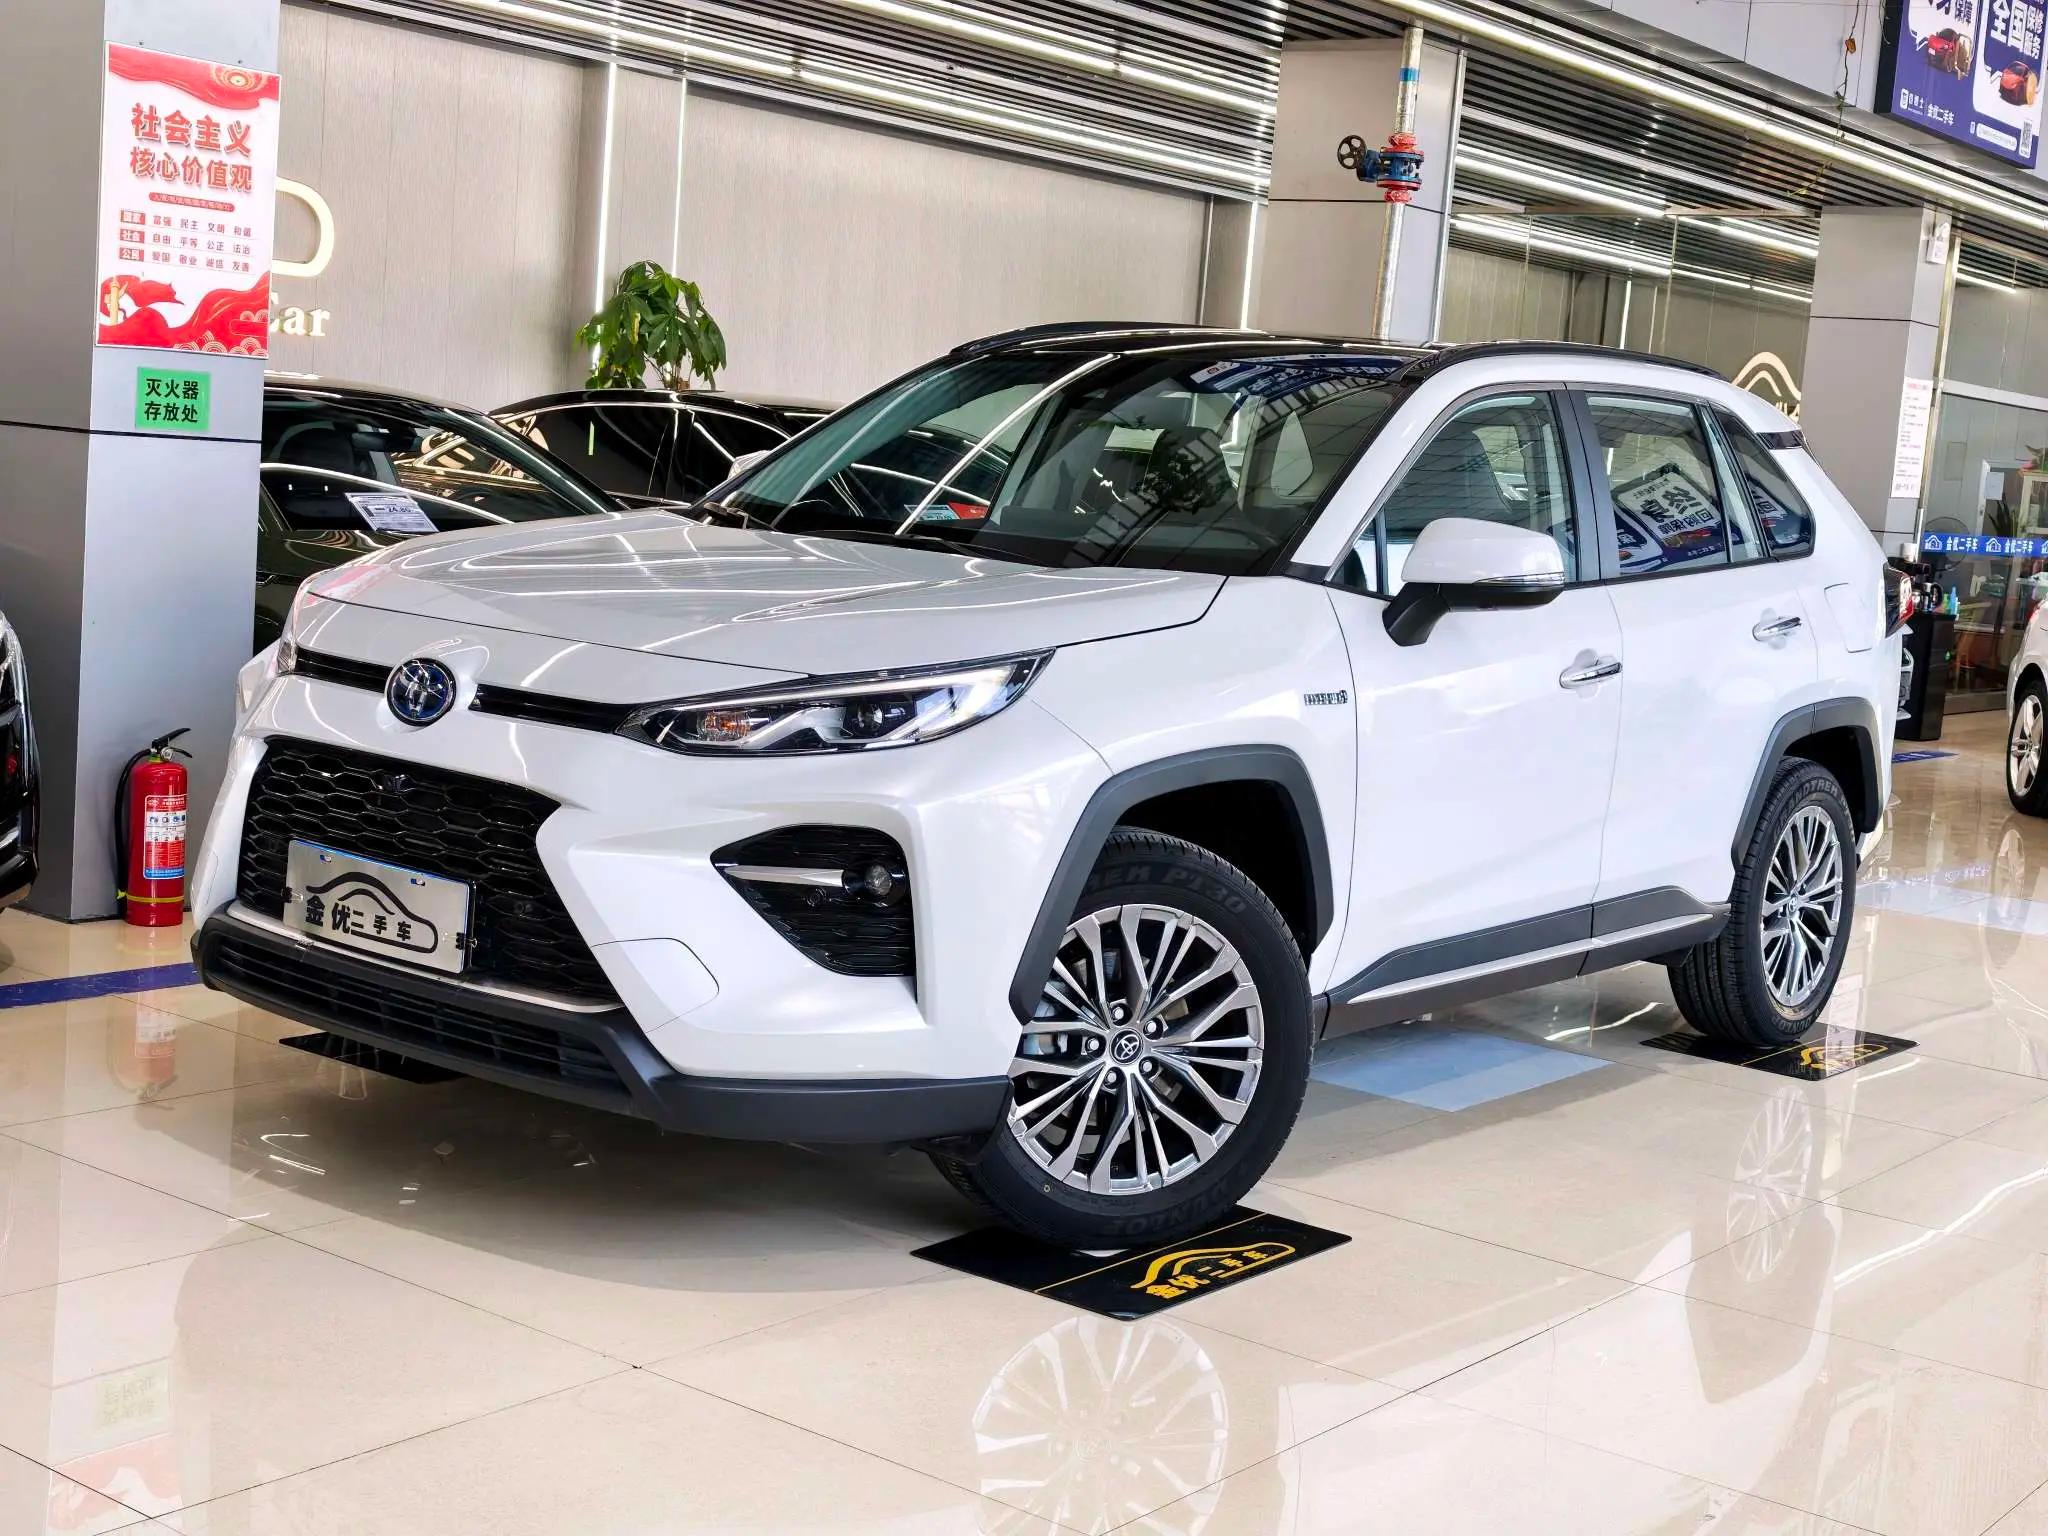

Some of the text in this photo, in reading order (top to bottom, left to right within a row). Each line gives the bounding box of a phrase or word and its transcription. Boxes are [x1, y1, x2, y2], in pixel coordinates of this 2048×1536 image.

[131, 103, 251, 157] 社会主义
[130, 146, 252, 193] 核心价值观
[153, 233, 171, 244] 自由
[207, 240, 224, 251] 公正
[270, 292, 331, 337] ar
[145, 378, 199, 400] 灭火器
[144, 401, 198, 423] 存放处
[305, 895, 412, 941] 金优二手车
[1146, 1251, 1268, 1299] 金优二手车
